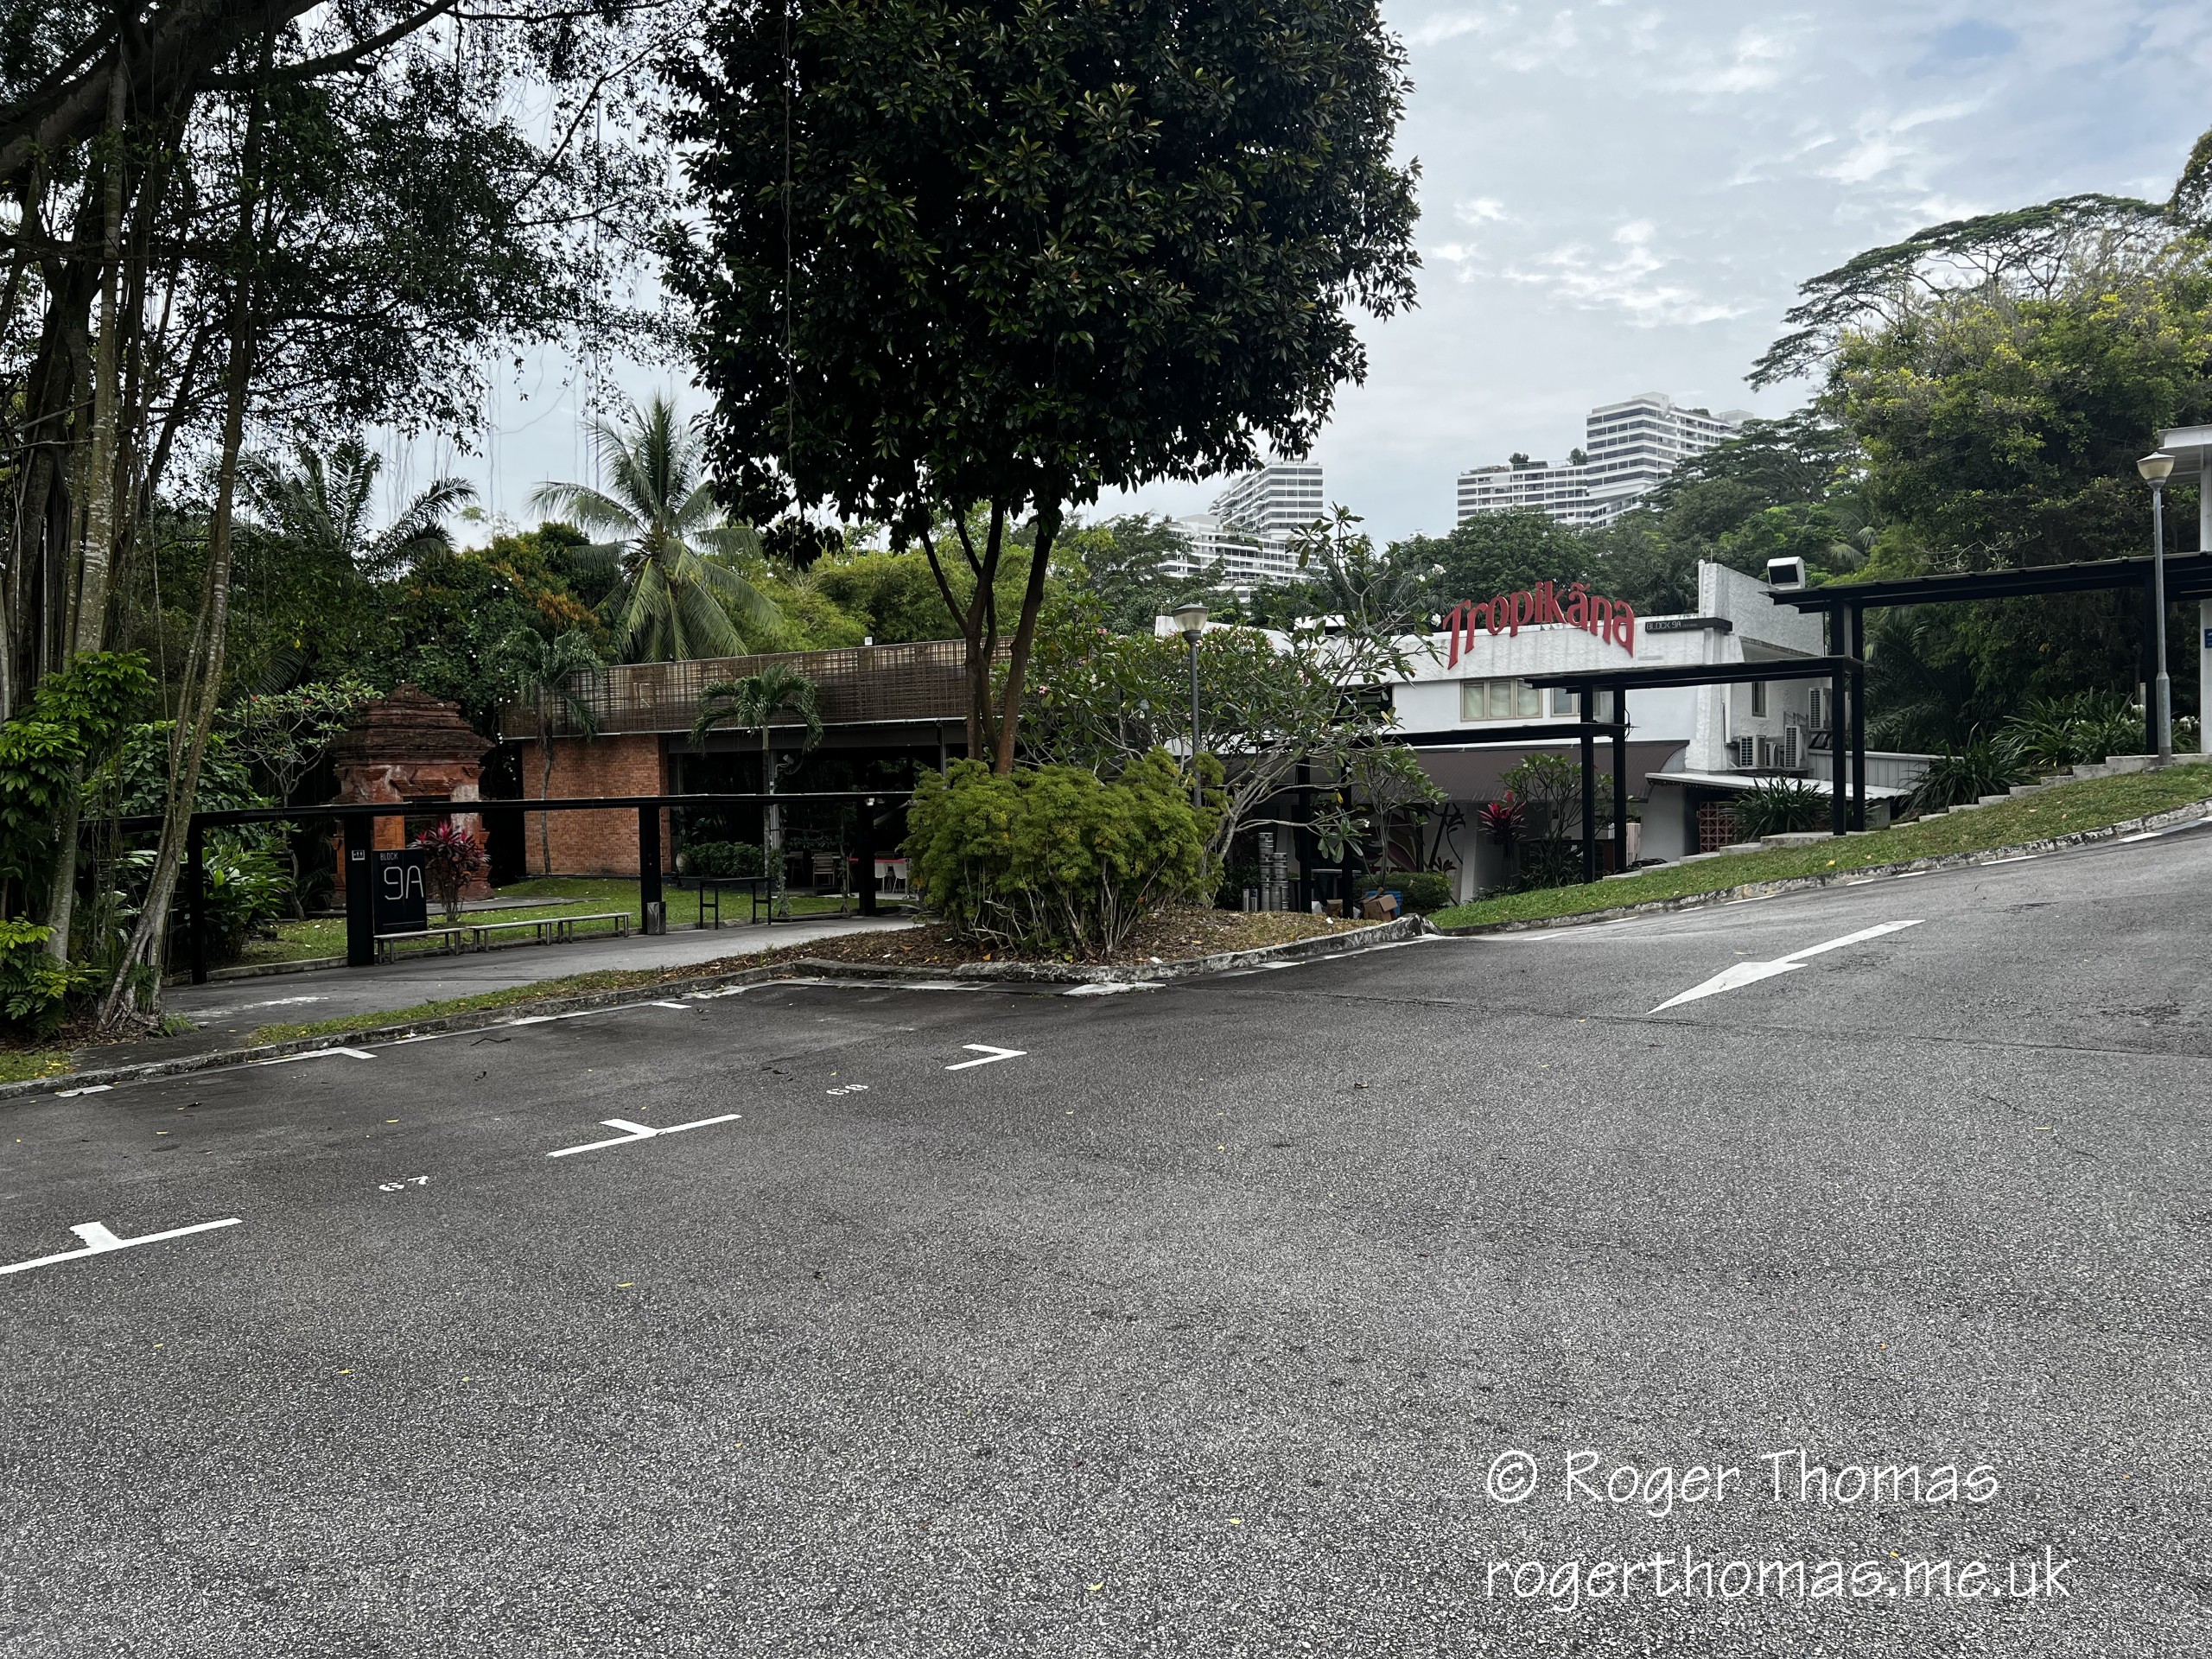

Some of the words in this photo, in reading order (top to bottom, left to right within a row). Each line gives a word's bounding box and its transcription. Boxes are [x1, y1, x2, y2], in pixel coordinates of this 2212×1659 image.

[1646, 621, 1670, 630] BLOCK
[380, 852, 398, 861] BLOCK
[384, 865, 424, 900] 9A
[825, 1084, 869, 1096] 68
[378, 1175, 429, 1192] 67
